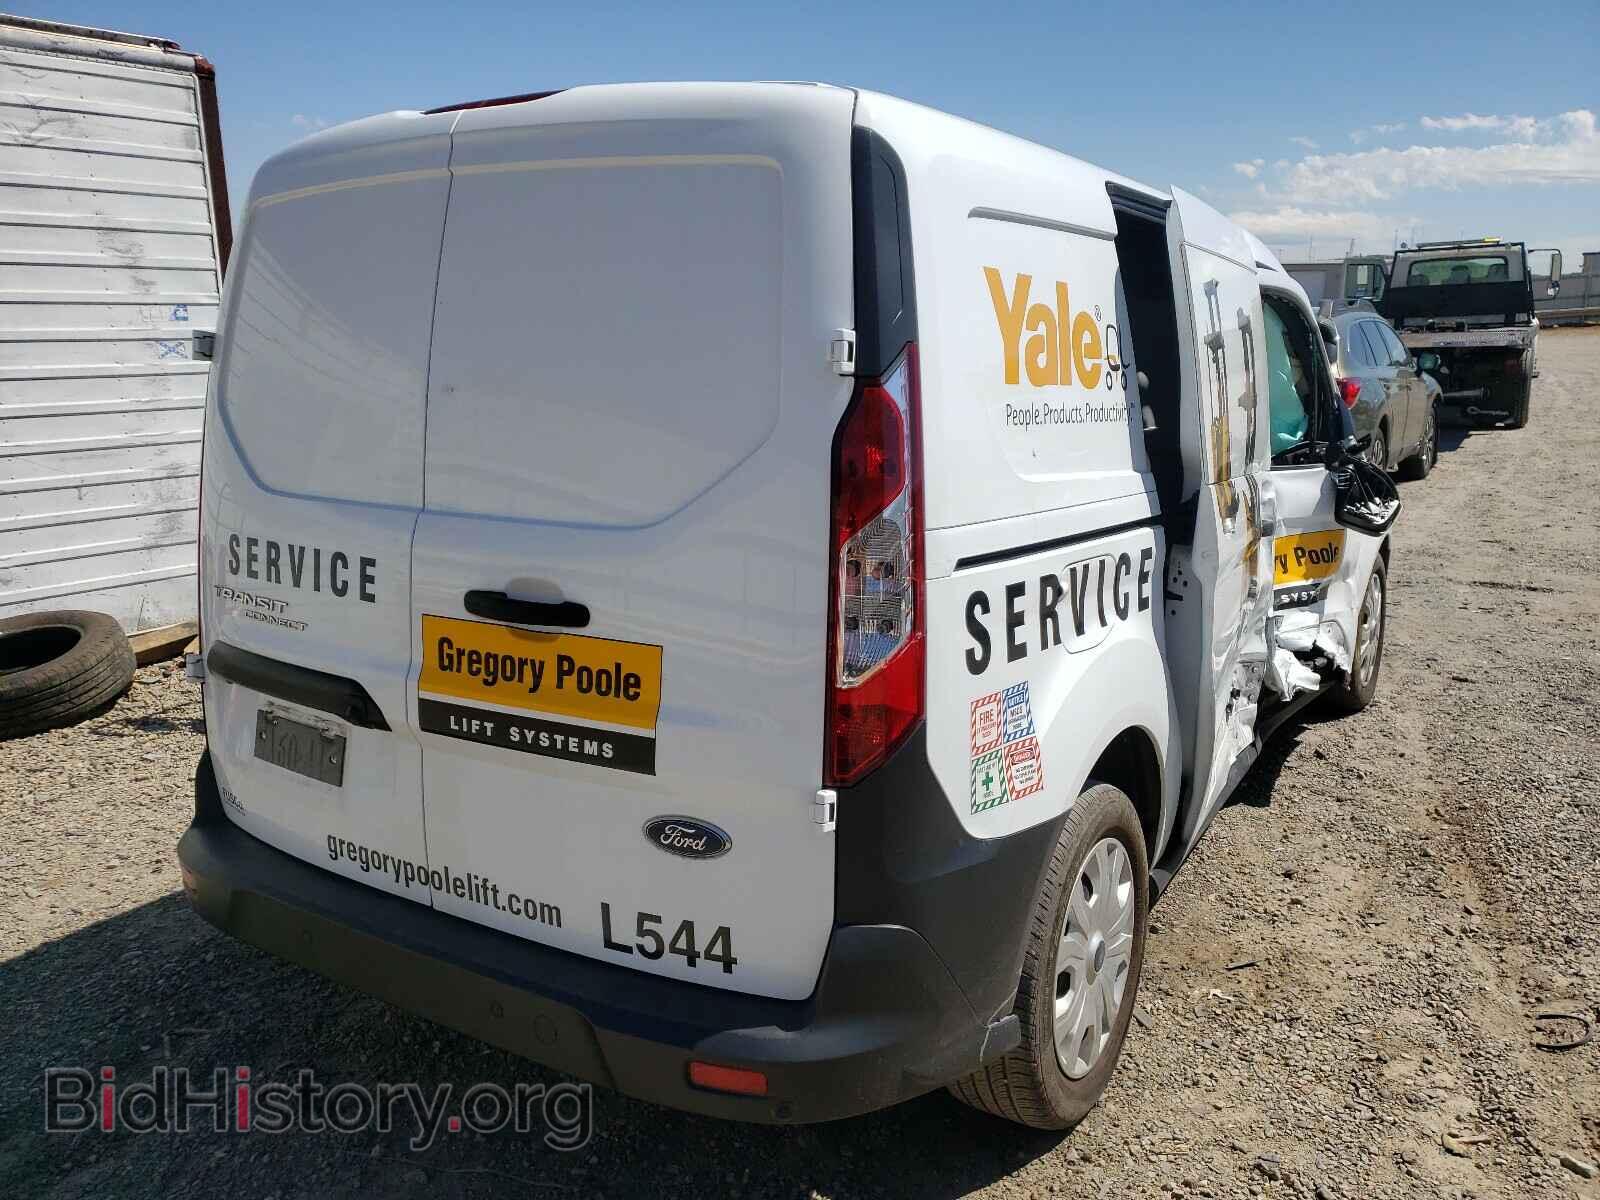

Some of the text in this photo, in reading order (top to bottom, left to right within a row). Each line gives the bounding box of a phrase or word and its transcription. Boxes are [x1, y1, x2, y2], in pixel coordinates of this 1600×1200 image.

[983, 266, 1103, 390] Yale
[214, 584, 289, 614] TRANSIT
[228, 533, 377, 604] SERVICE
[245, 608, 309, 633] CONNECT
[965, 547, 1153, 676] SERVICE
[437, 636, 642, 702] Gregory Poole
[449, 714, 615, 759] LIFT SYSTEMS
[979, 708, 994, 726] FIRE
[660, 824, 708, 851] Ford
[326, 833, 563, 929] gregorypoolelift.com
[600, 901, 738, 975] L544
